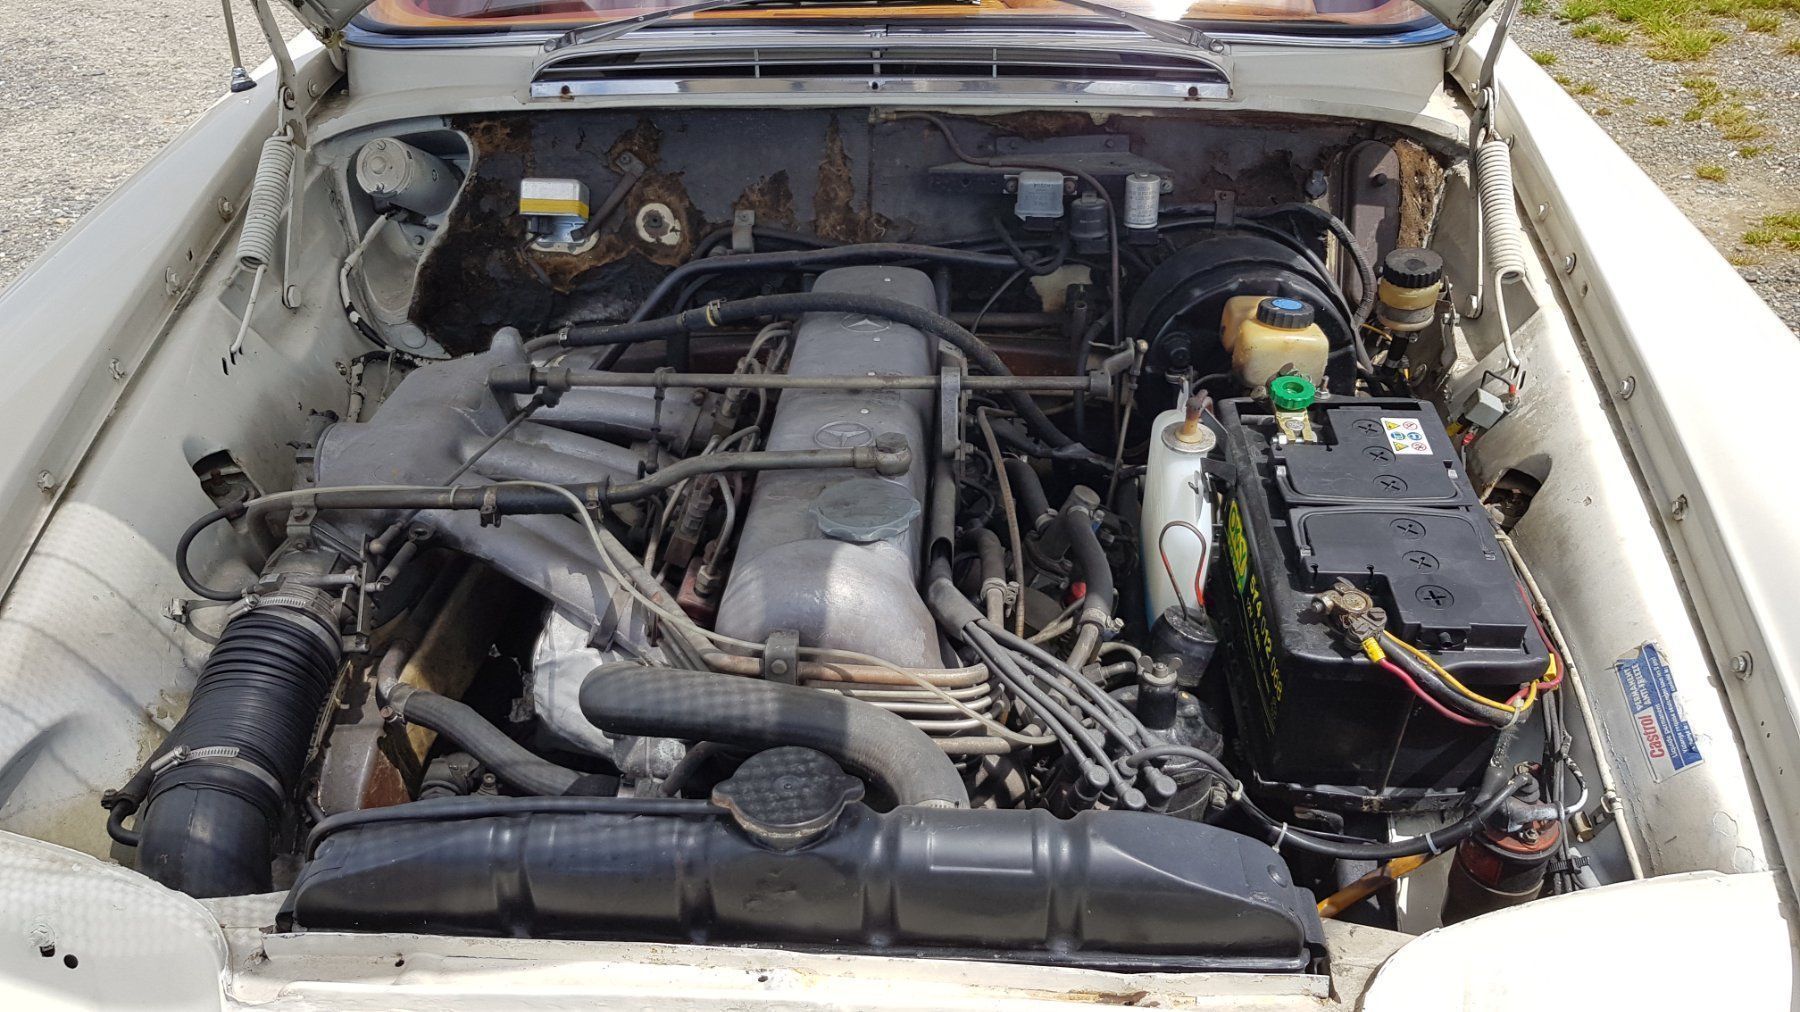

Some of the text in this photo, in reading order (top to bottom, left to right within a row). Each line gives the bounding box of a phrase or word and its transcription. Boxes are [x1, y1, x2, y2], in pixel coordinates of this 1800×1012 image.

[1624, 667, 1644, 711] PERMANENT
[1632, 663, 1651, 705] ANTI-FREEZE
[1638, 715, 1665, 759] Castrol
